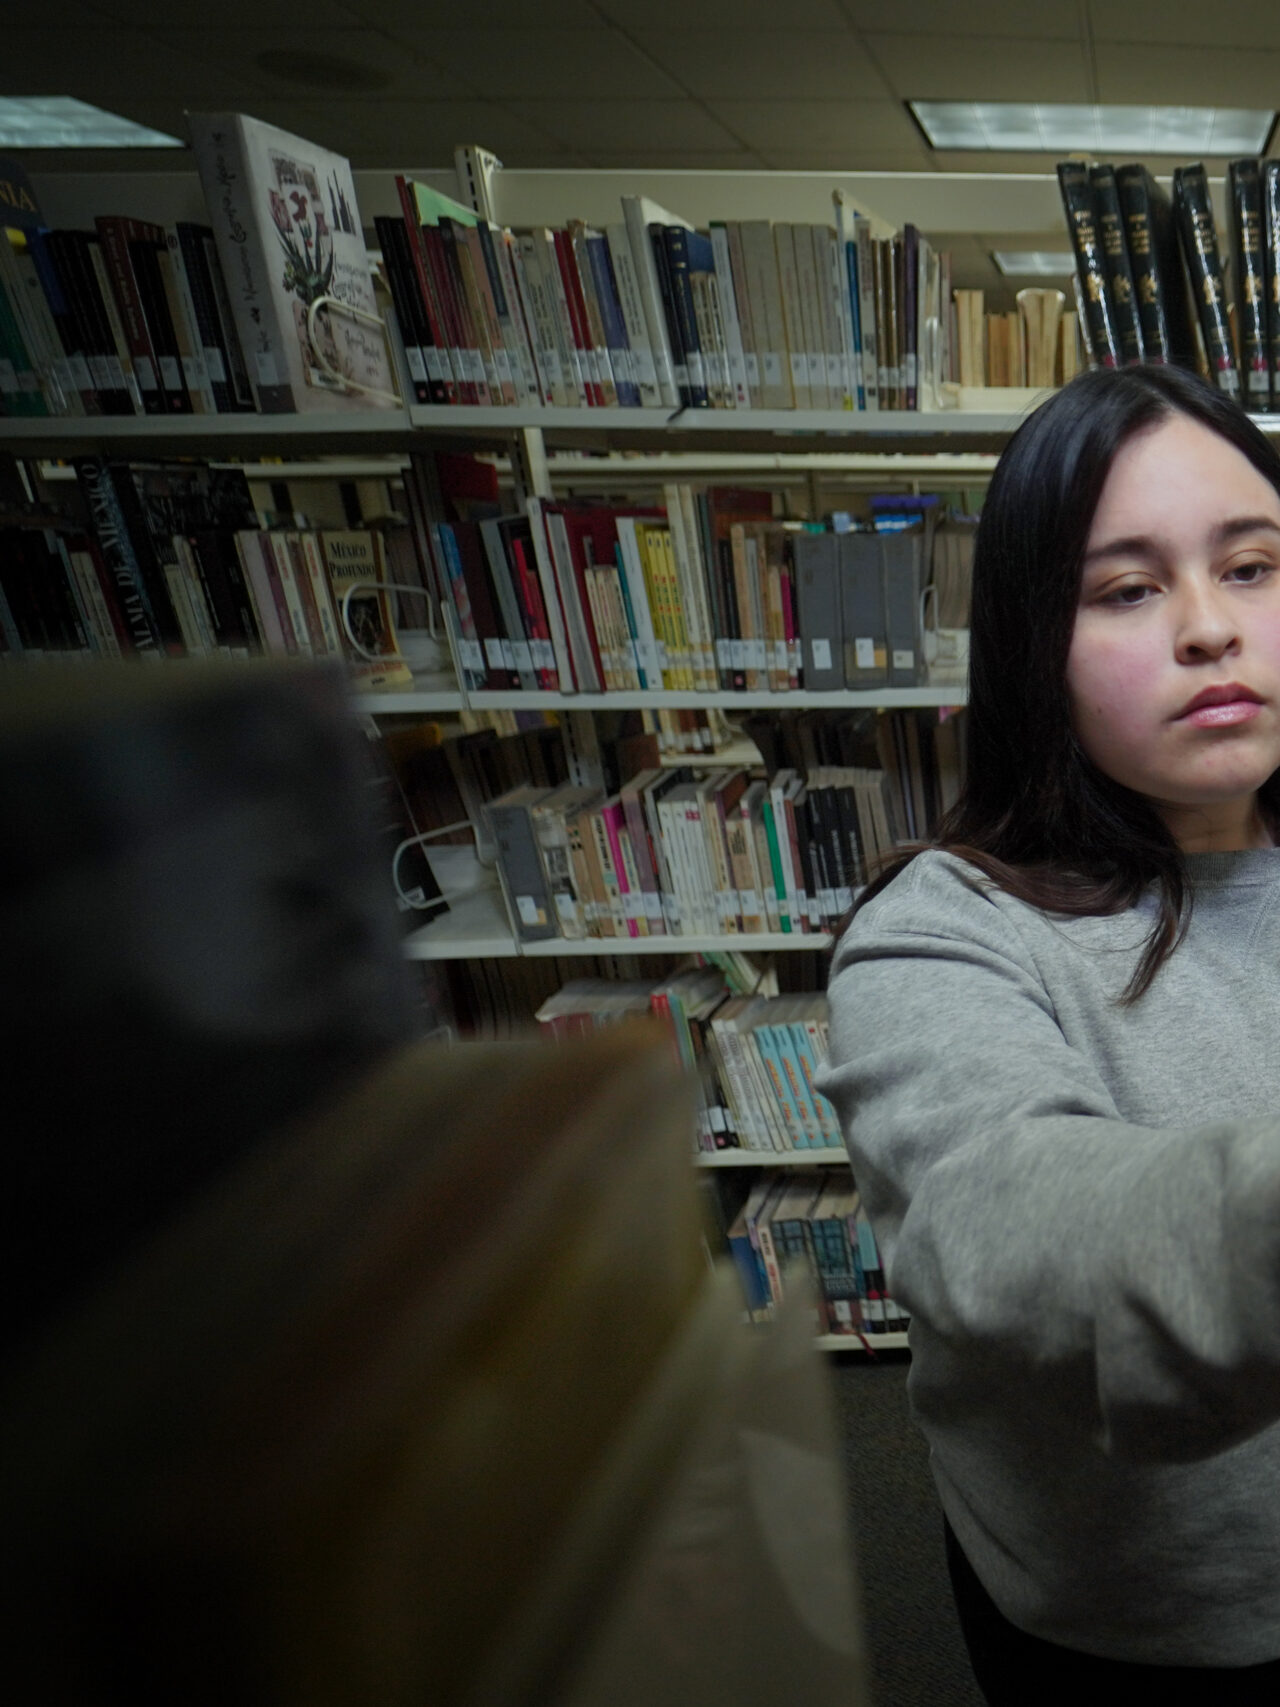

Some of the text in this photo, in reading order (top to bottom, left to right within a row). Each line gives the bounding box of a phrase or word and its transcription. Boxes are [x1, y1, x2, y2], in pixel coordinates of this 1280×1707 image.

[113, 565, 135, 588] DE
[329, 560, 375, 579] PROFUNDO
[125, 594, 154, 648] ALMA
